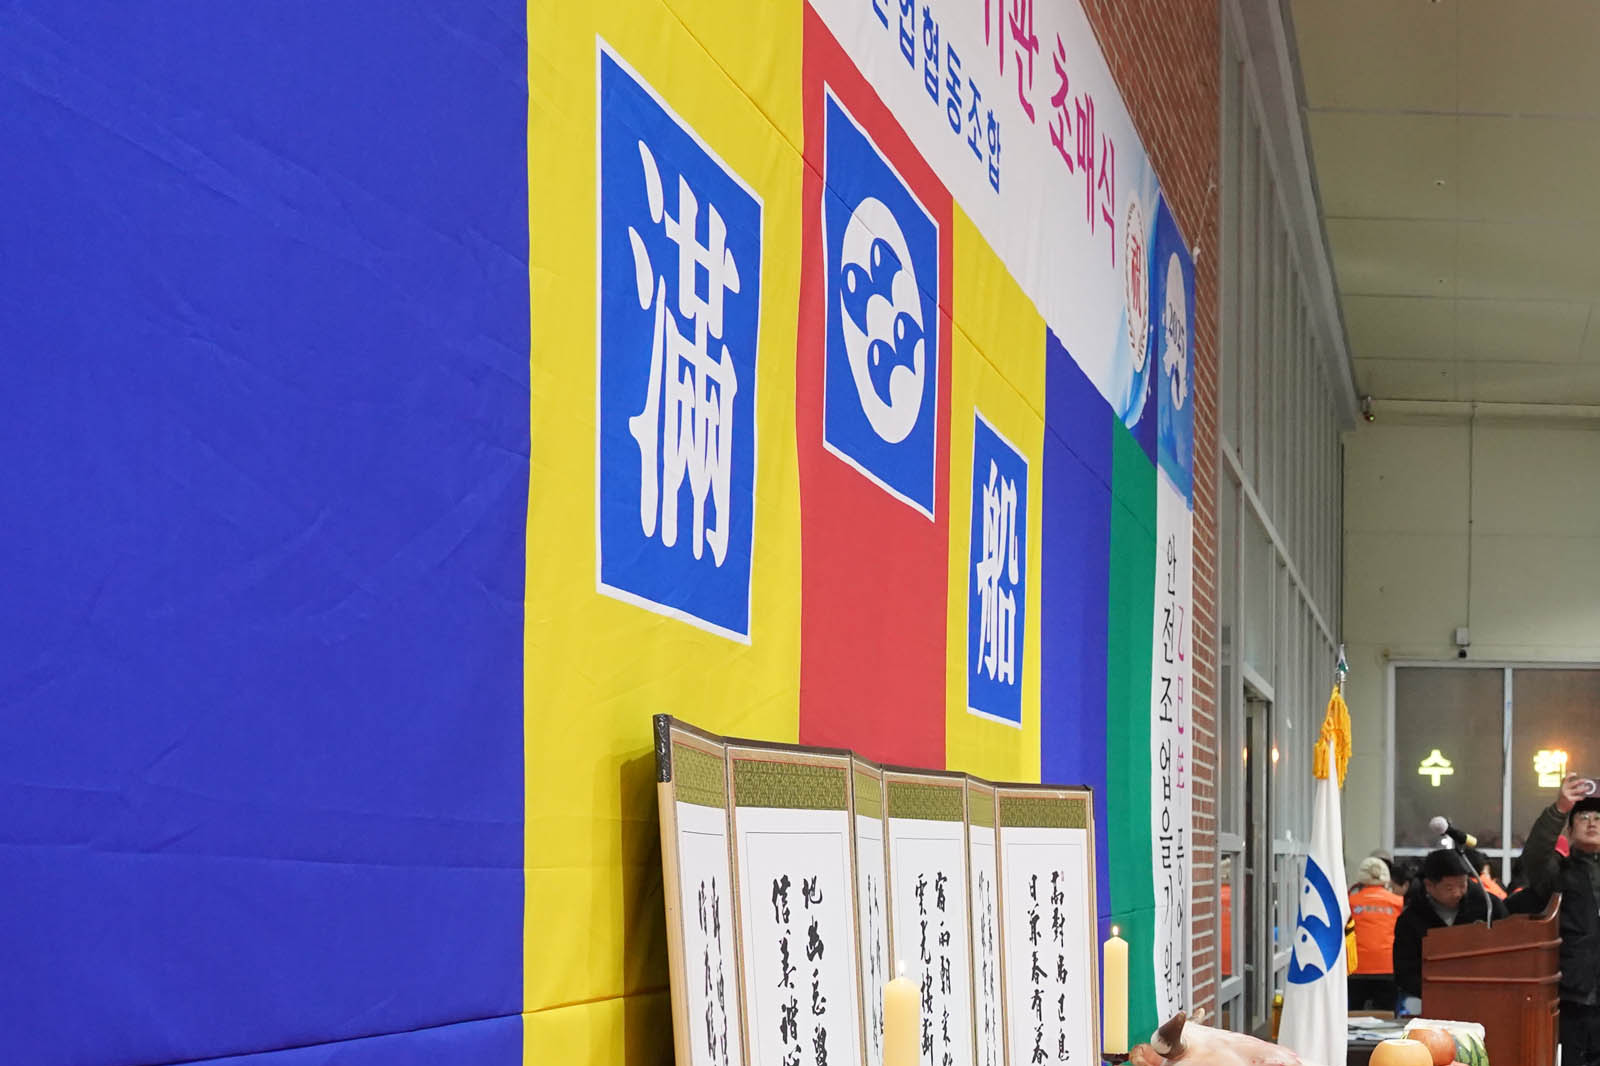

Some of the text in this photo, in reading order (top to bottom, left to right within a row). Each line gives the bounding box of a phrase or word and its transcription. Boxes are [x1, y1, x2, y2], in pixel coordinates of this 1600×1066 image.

[1049, 32, 1115, 269] 초매식
[976, 458, 1020, 685] 船
[1159, 533, 1177, 1018] 안전조업을기원
